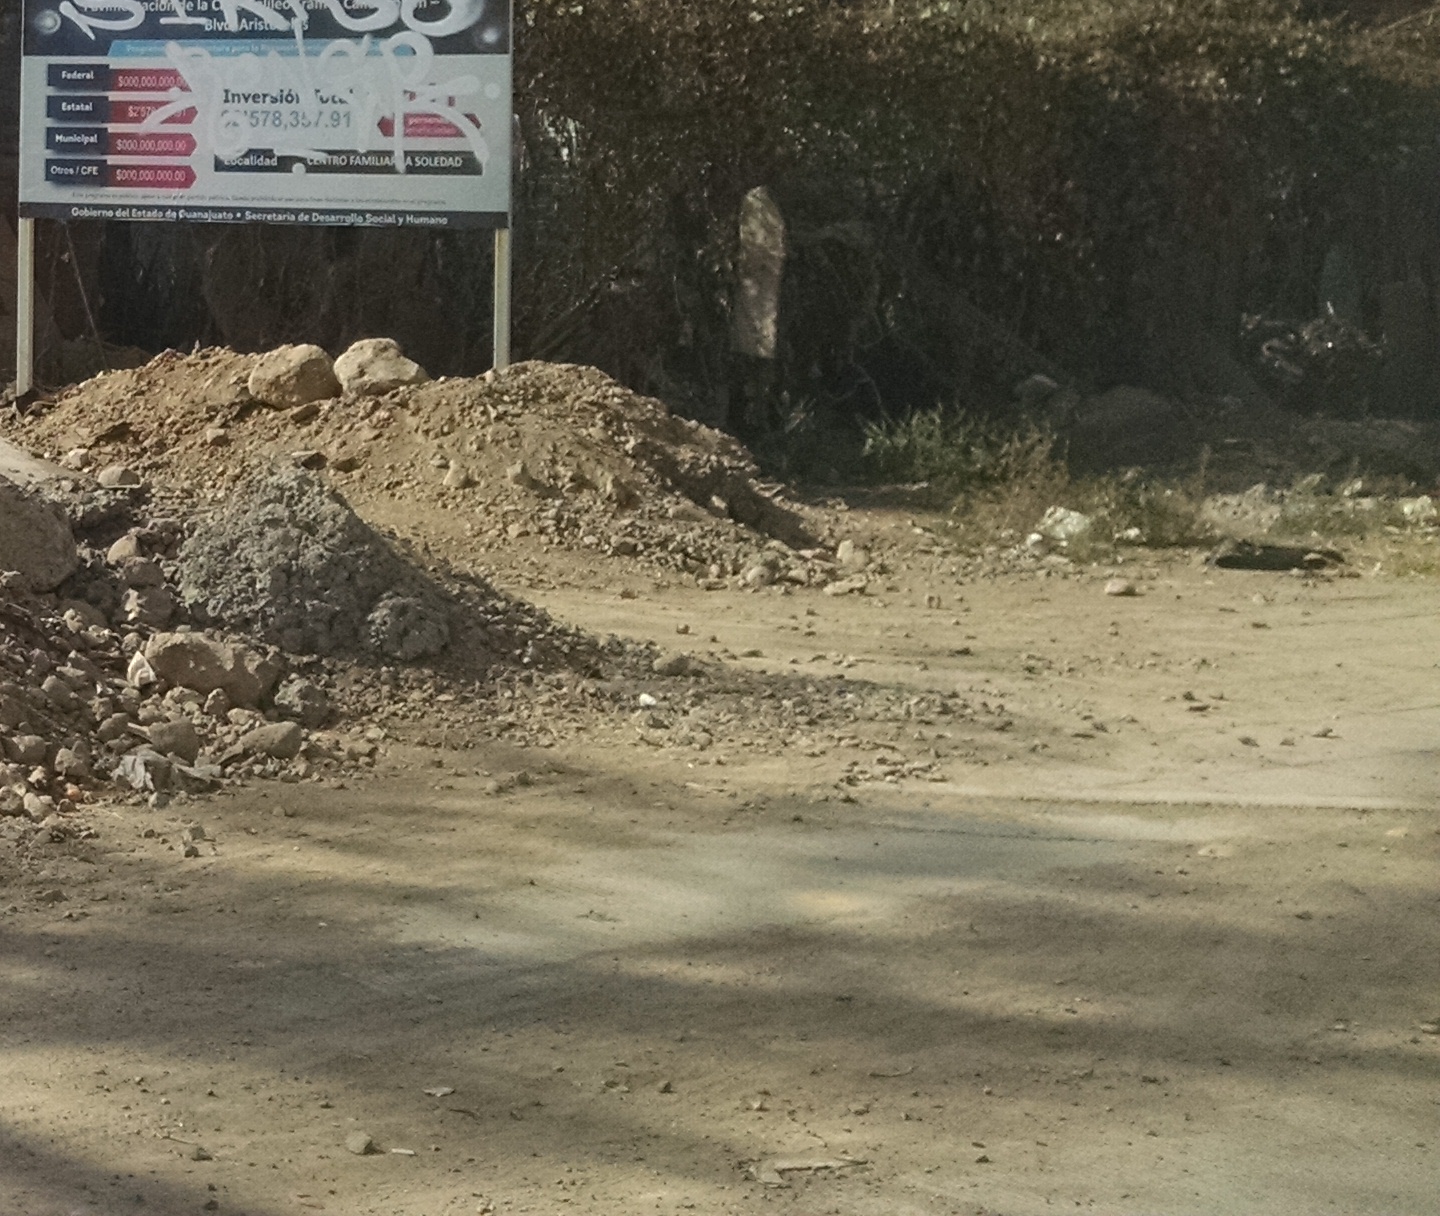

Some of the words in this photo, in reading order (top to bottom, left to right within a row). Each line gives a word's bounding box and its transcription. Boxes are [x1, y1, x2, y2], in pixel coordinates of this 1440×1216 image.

[61, 70, 95, 80] Federal
[61, 102, 94, 112] Estatal
[55, 134, 98, 146] Municipal
[415, 155, 463, 167] SOLEDAD
[50, 165, 74, 175] Otros
[81, 165, 99, 175] CFE
[71, 207, 113, 218] Gobierno
[115, 208, 129, 218] del
[131, 208, 163, 219] Estado
[165, 209, 177, 219] de
[179, 209, 233, 222] Guanajuato
[297, 212, 309, 222] de
[311, 213, 363, 223] Desarrollo
[365, 213, 396, 224] Social
[406, 215, 448, 225] Humano
